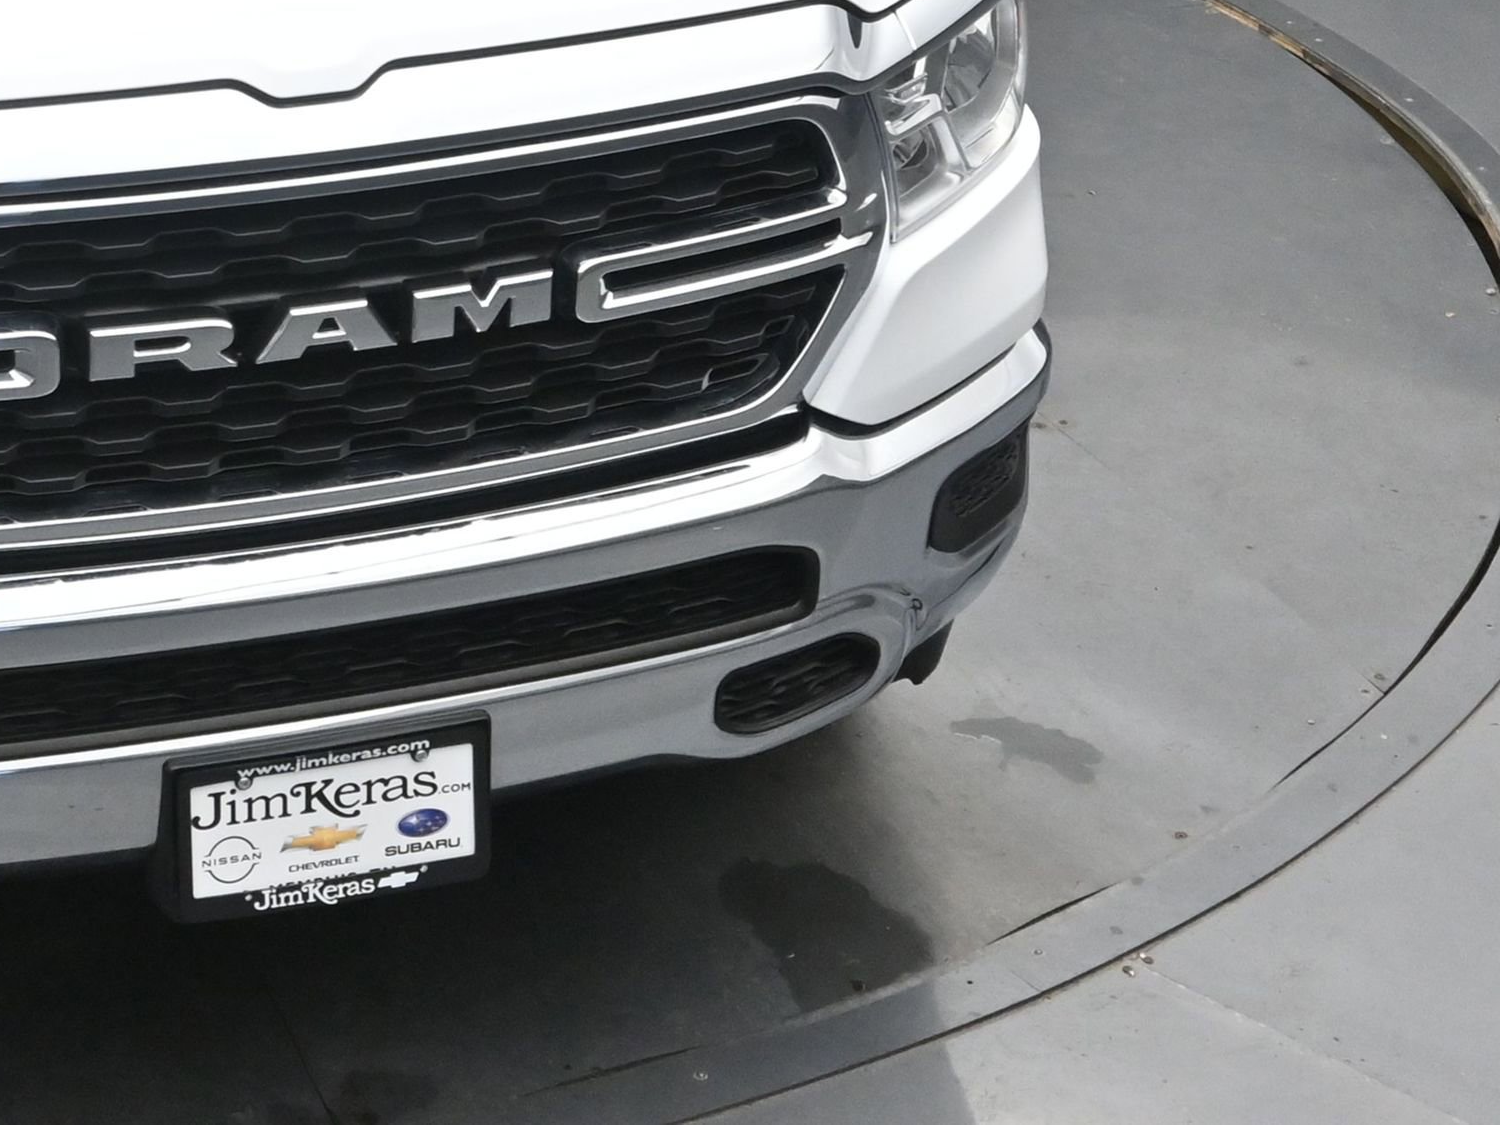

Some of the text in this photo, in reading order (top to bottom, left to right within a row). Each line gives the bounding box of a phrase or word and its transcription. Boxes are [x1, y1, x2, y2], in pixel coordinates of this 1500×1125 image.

[89, 269, 553, 382] RAM
[237, 739, 430, 778] www.jimkeras.com
[385, 837, 461, 858] SUBARU
[201, 851, 262, 868] NISSAN
[288, 855, 360, 873] CHEVROLET
